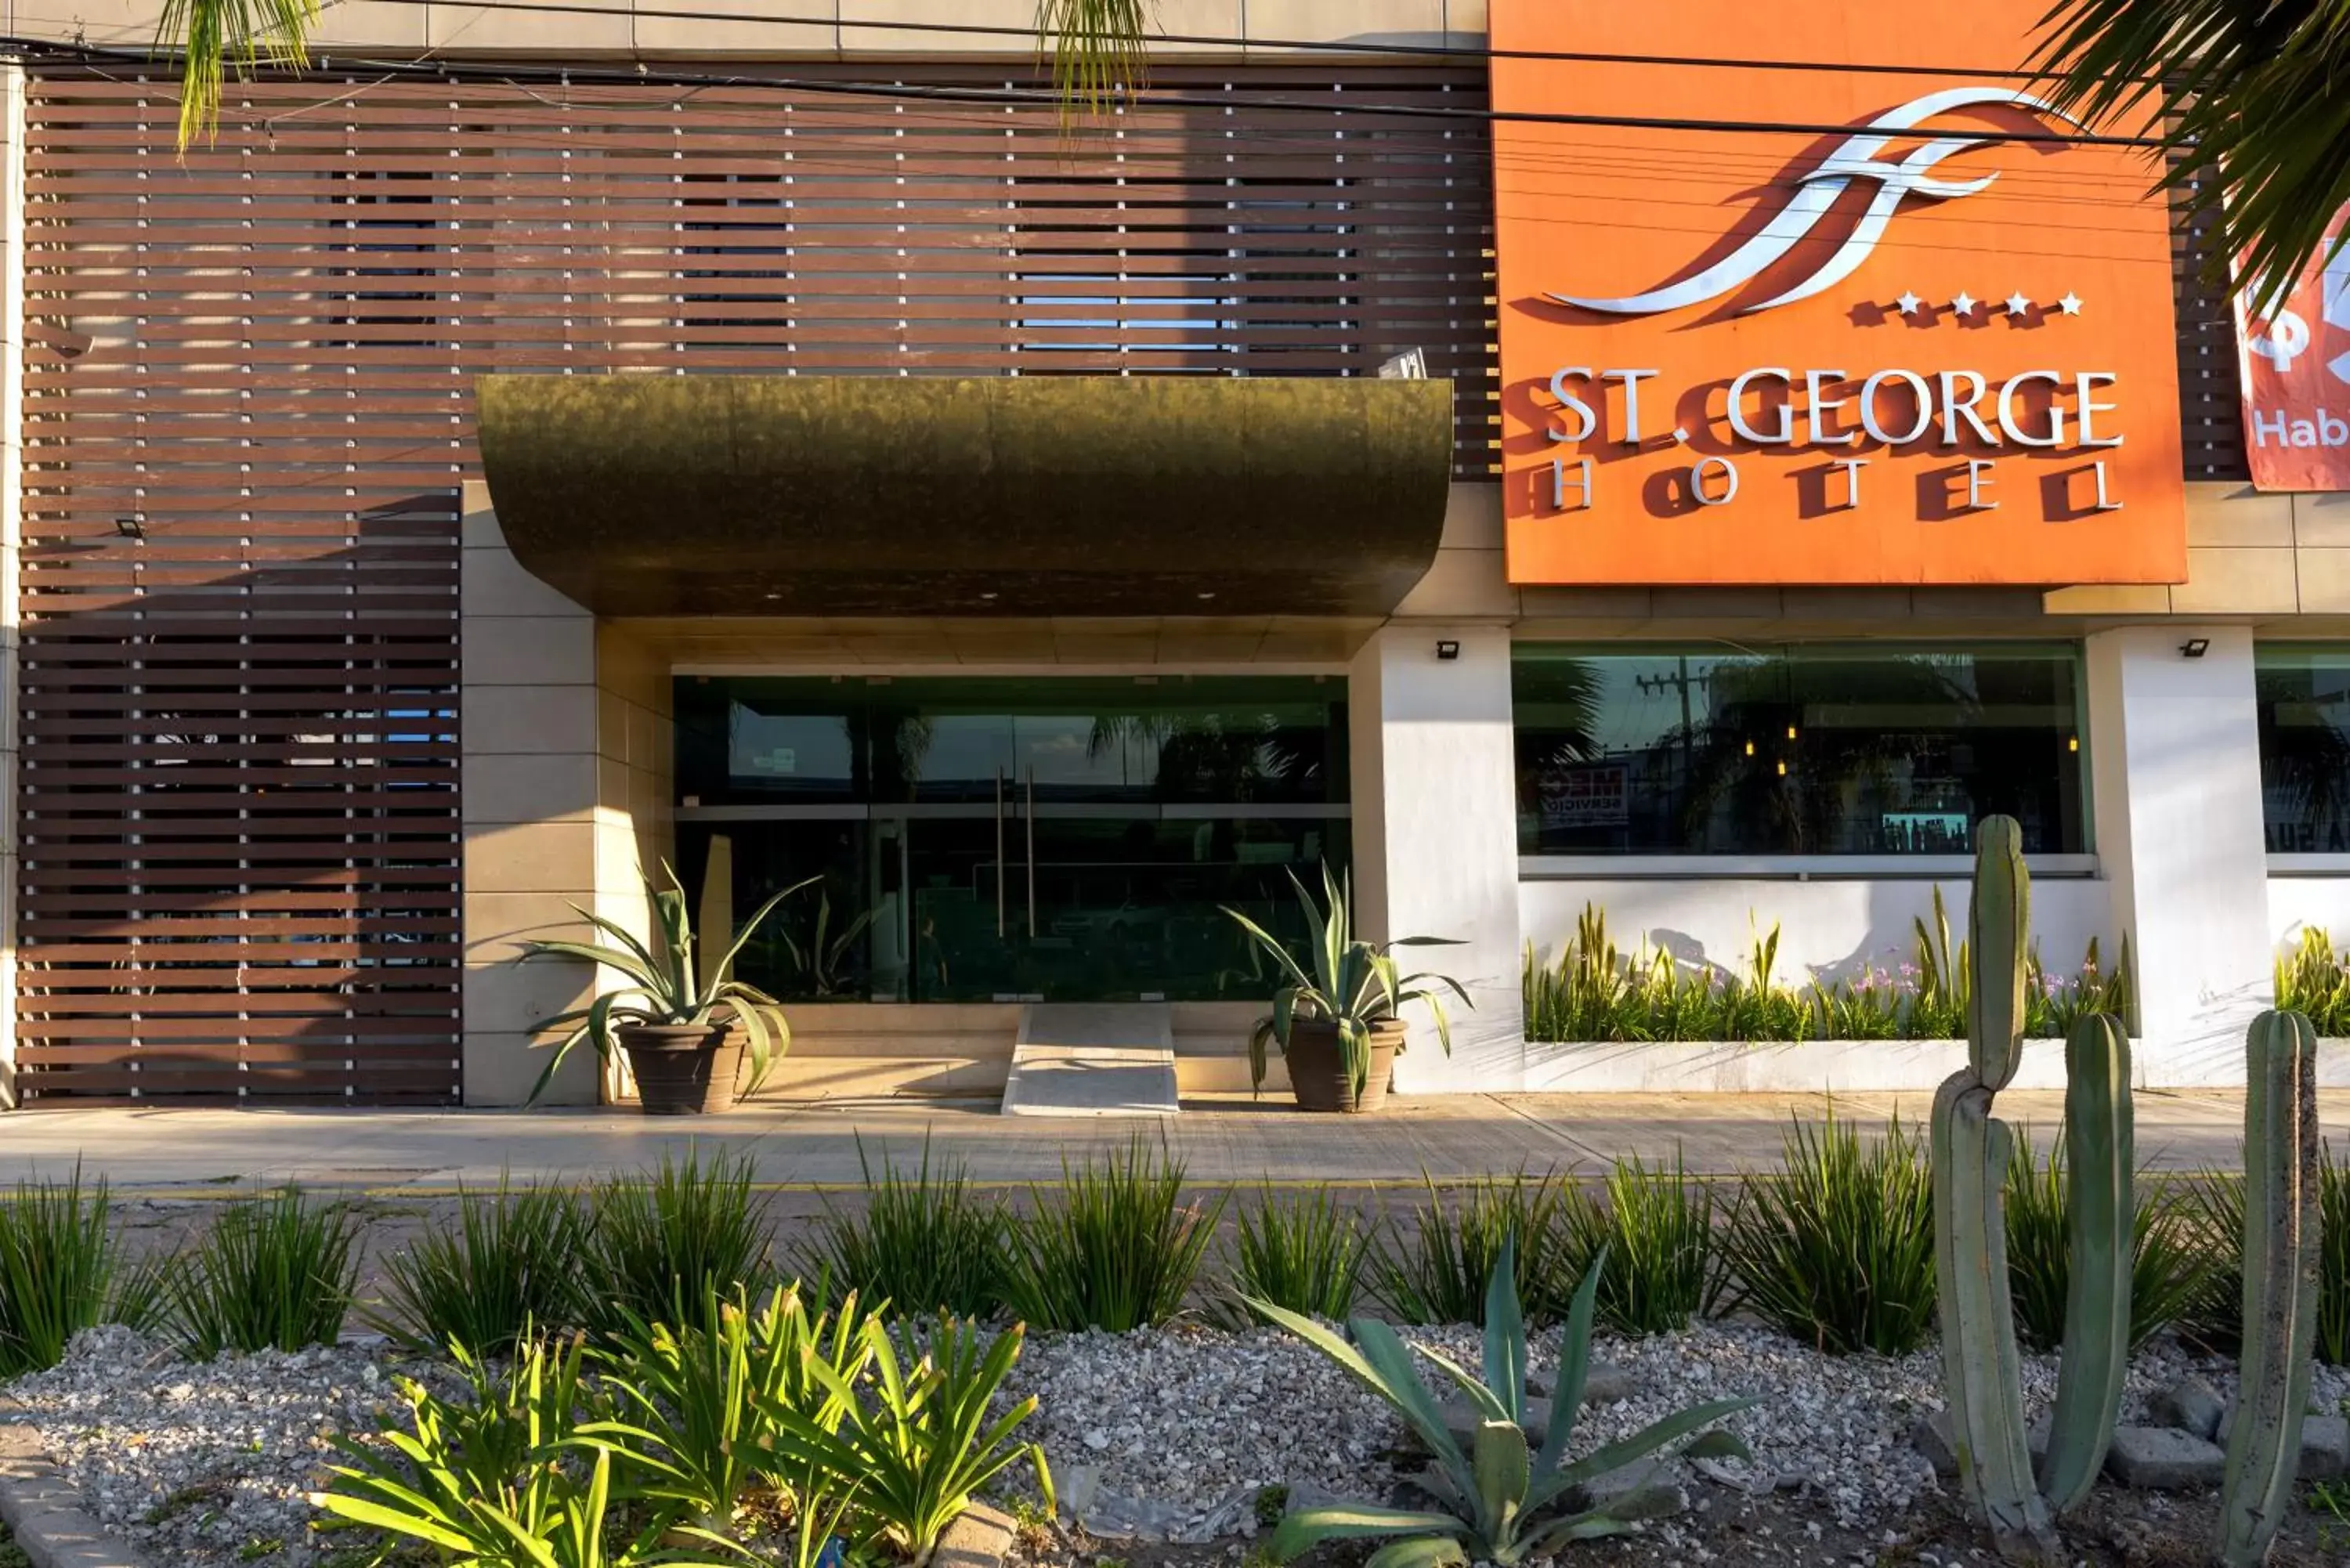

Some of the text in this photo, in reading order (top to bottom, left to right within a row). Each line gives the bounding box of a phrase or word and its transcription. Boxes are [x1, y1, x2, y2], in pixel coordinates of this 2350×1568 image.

[1549, 367, 2124, 446] ST. GEORGE
[2254, 408, 2350, 449] Hab
[1553, 457, 2124, 511] HOTEL
